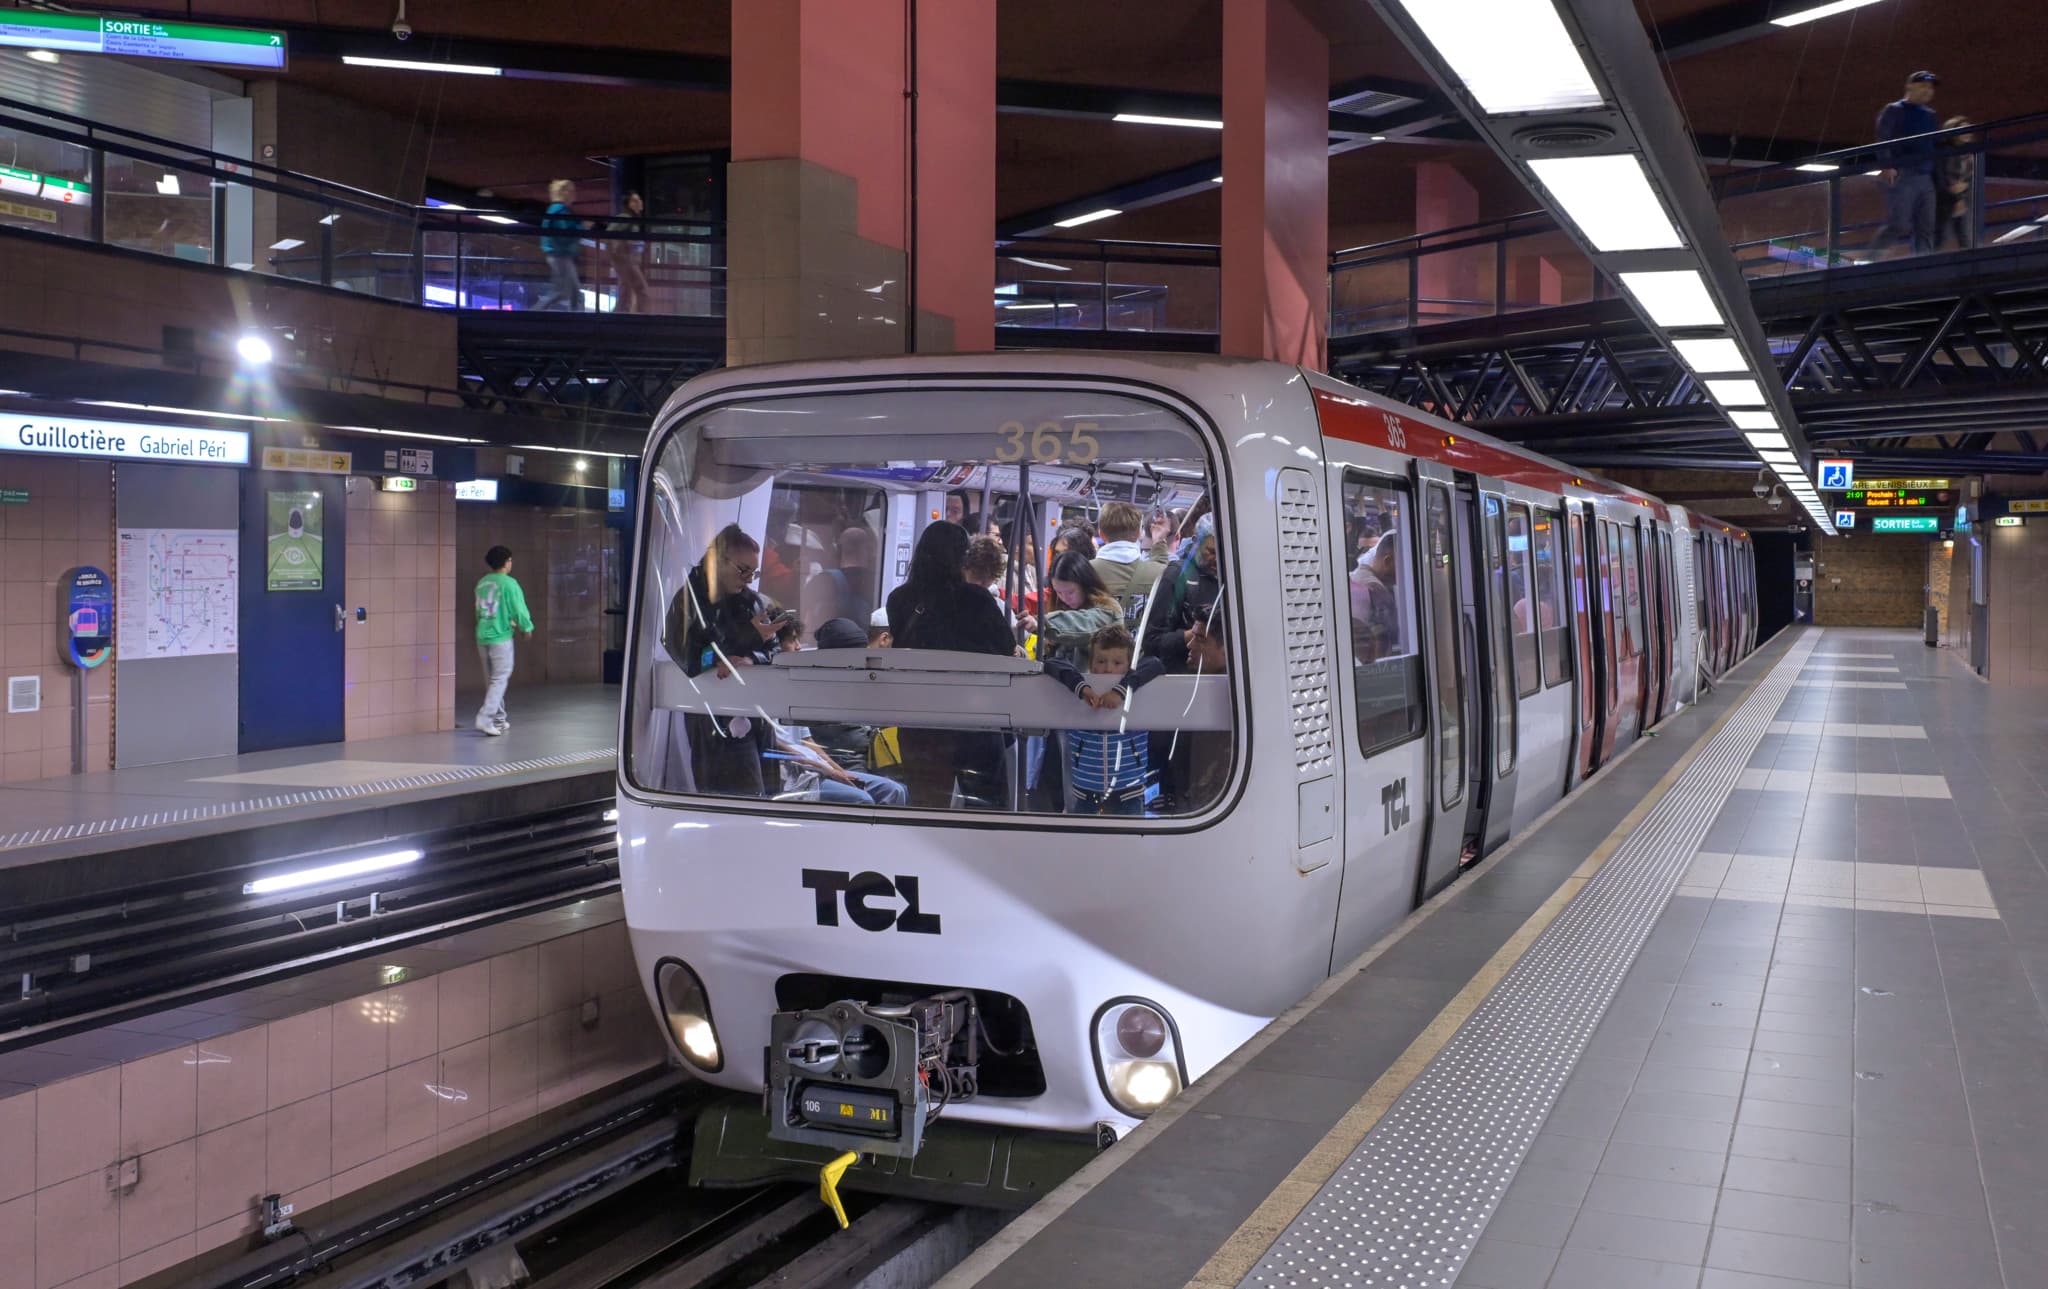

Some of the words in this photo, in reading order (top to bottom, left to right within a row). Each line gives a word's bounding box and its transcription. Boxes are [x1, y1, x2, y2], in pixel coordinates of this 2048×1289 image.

[106, 21, 150, 35] SORTIE
[19, 424, 126, 452] Guillotière
[140, 435, 193, 457] Gabriel
[199, 439, 226, 458] Péri
[1382, 412, 1407, 449] 365
[995, 421, 1100, 465] 365
[1846, 491, 1864, 499] 21:01
[1876, 481, 1929, 489] VENISSIEUX
[1874, 520, 1910, 529] SORTIE
[1381, 776, 1410, 837] TCL
[801, 868, 942, 935] TCL
[805, 1100, 821, 1112] 106
